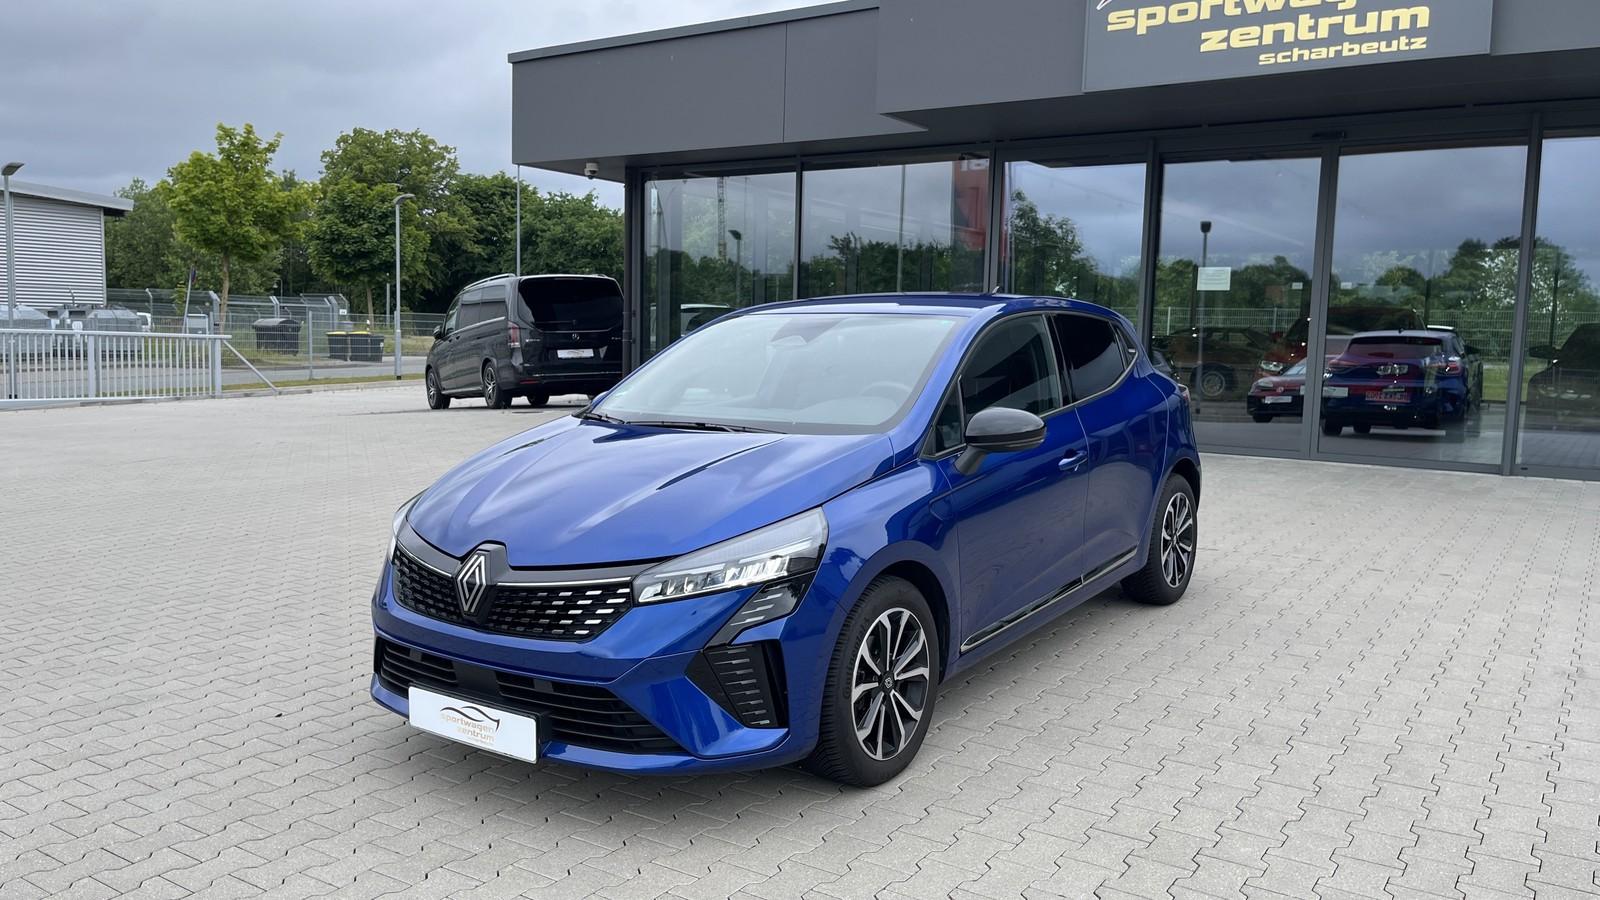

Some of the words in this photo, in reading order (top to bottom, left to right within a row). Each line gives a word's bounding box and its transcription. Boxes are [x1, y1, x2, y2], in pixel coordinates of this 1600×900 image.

[1200, 5, 1430, 53] zentrum
[1259, 36, 1427, 66] scharbeutz
[440, 711, 495, 733] sportwagen
[457, 725, 495, 742] zentrum
